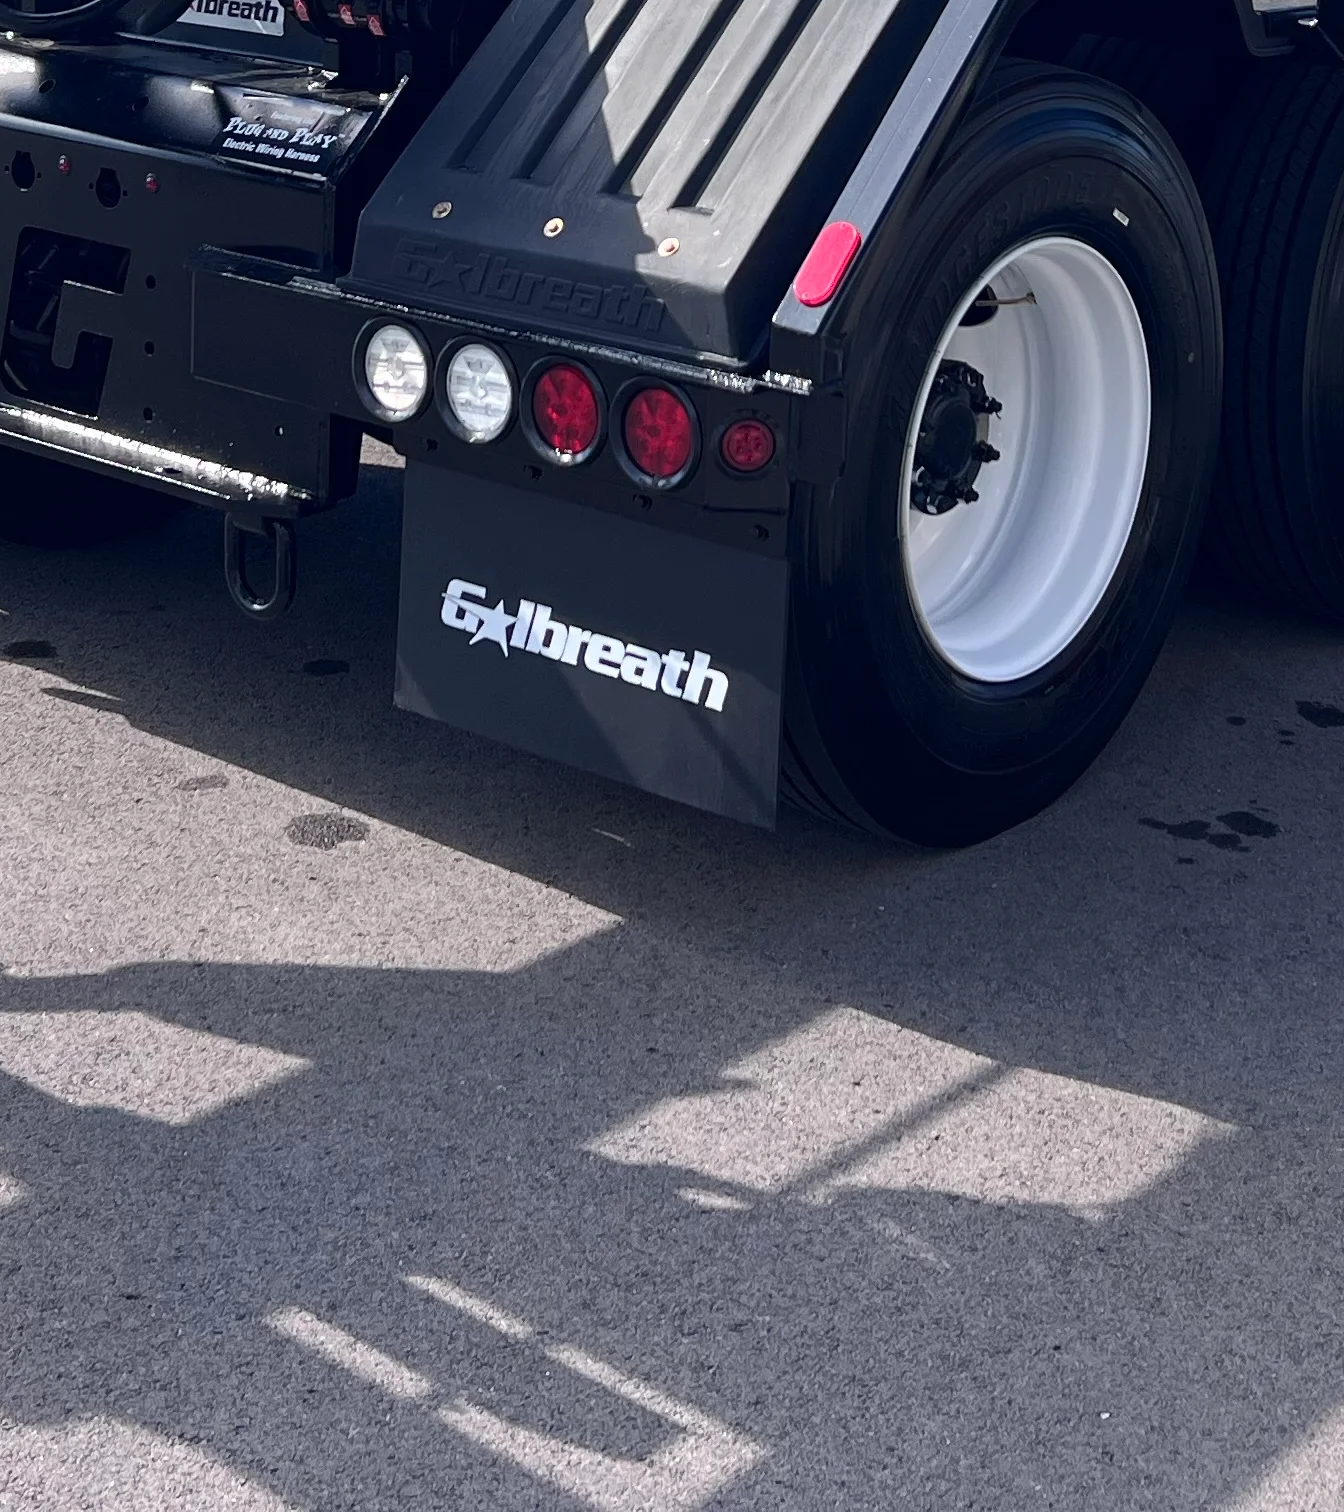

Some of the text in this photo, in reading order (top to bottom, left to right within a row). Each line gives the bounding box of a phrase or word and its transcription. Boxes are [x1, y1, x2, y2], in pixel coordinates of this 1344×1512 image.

[222, 137, 321, 163] Electric Wiring Harness
